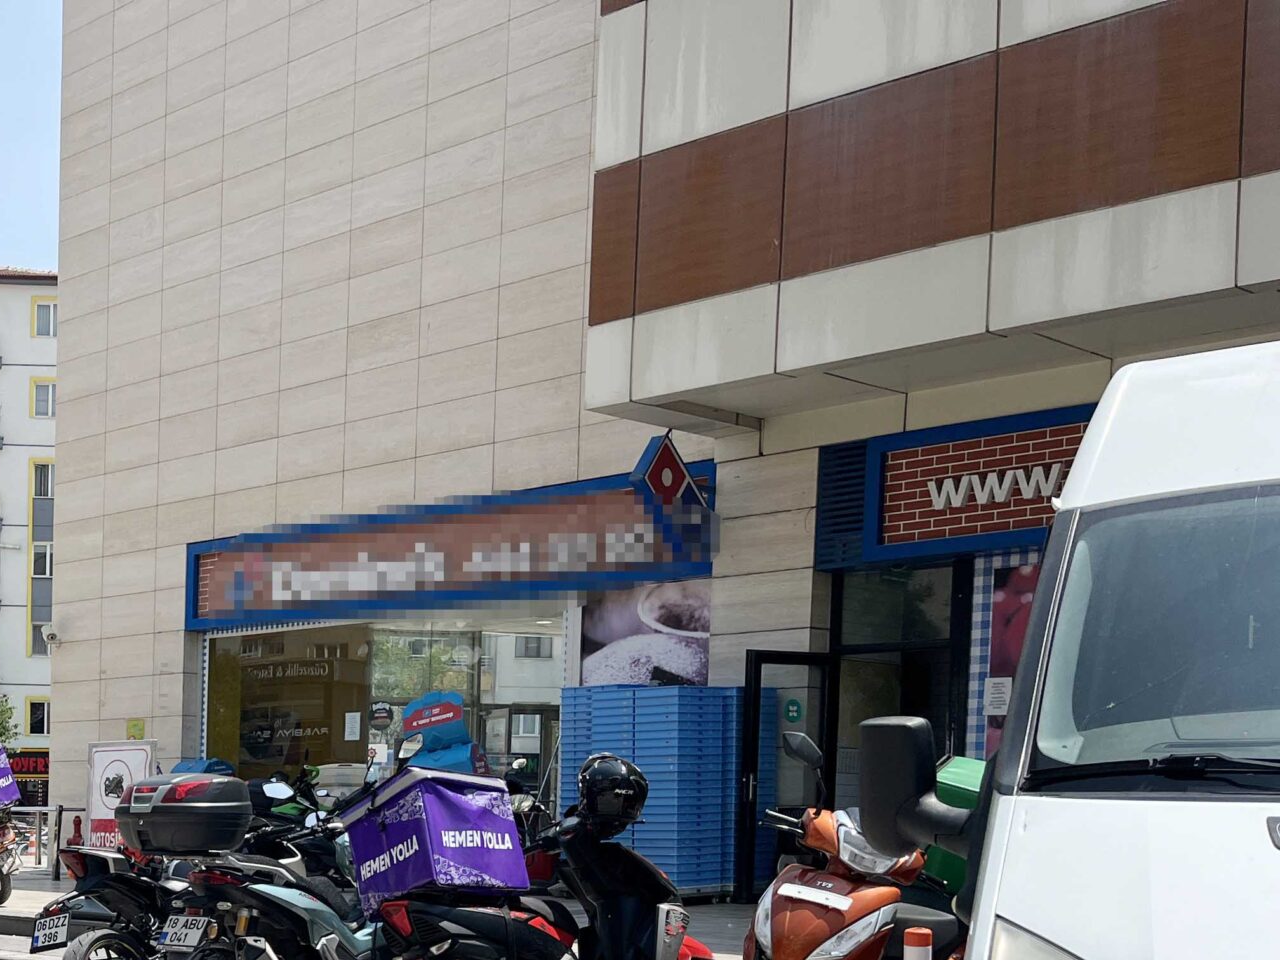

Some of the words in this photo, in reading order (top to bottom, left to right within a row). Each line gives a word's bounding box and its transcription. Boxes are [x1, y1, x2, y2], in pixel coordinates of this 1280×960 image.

[0, 775, 14, 789] YOLLA
[90, 828, 122, 847] MOTOSİ
[441, 830, 481, 848] HEMEN
[481, 831, 513, 850] YOLLA
[360, 852, 391, 882] HEMEN
[391, 834, 419, 865] YOLLA
[36, 920, 47, 932] 06
[47, 916, 67, 930] DZZ
[169, 917, 177, 929] 18
[180, 917, 206, 931] ABU
[41, 931, 58, 944] 396
[170, 932, 188, 943] 041
